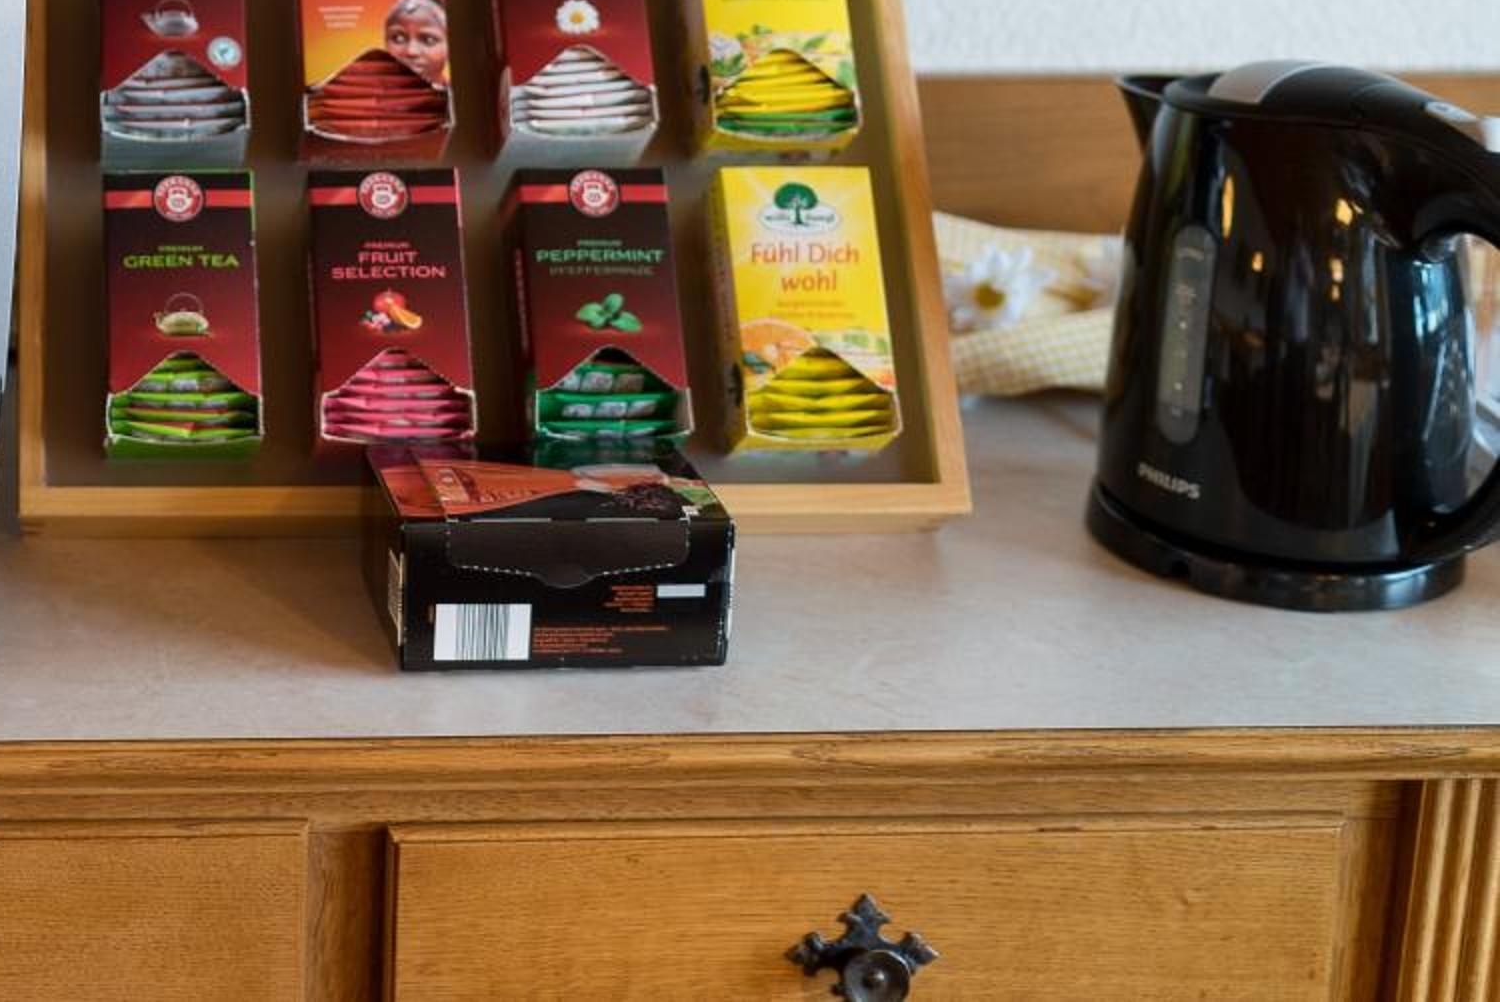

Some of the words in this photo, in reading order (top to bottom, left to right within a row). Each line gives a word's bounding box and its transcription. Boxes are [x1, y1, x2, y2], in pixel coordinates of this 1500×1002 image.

[357, 250, 419, 263] FRUIT
[535, 249, 664, 263] PEPPERMINT
[751, 242, 800, 263] Fühl
[808, 242, 860, 263] Dich
[122, 255, 193, 268] GREEN
[198, 254, 240, 268] TEA
[331, 265, 446, 279] SELECTION
[781, 269, 838, 292] wohl
[1137, 462, 1201, 499] PHILIPS
